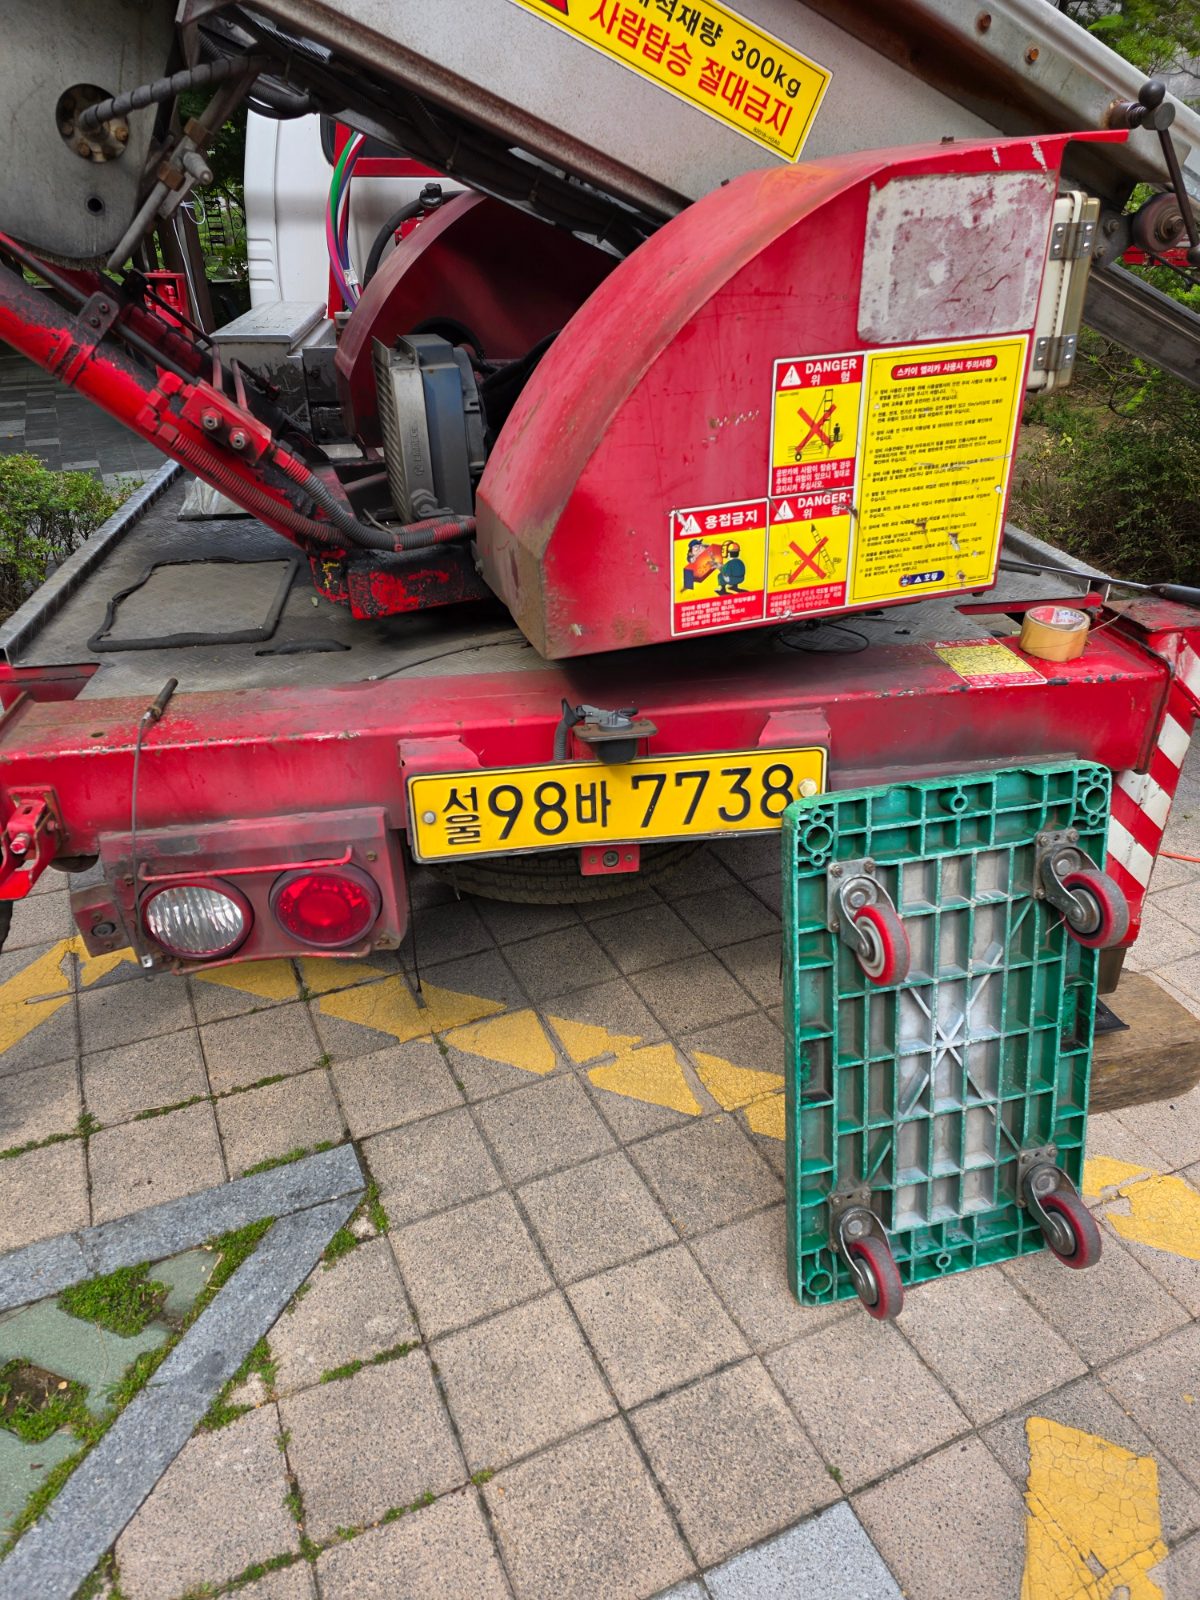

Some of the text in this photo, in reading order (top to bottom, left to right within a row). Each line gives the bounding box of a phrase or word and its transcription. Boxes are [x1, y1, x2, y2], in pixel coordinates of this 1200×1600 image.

[637, 0, 801, 99] 적재량 300kg
[589, 0, 793, 137] 사람탑승 절대금지
[805, 358, 857, 374] DANGER
[897, 366, 918, 377] 스카이
[943, 362, 963, 372] 사용시
[966, 358, 993, 370] 주의사항
[798, 492, 847, 508] DANGER
[705, 510, 757, 529] 용접금지
[631, 764, 795, 829] 7738
